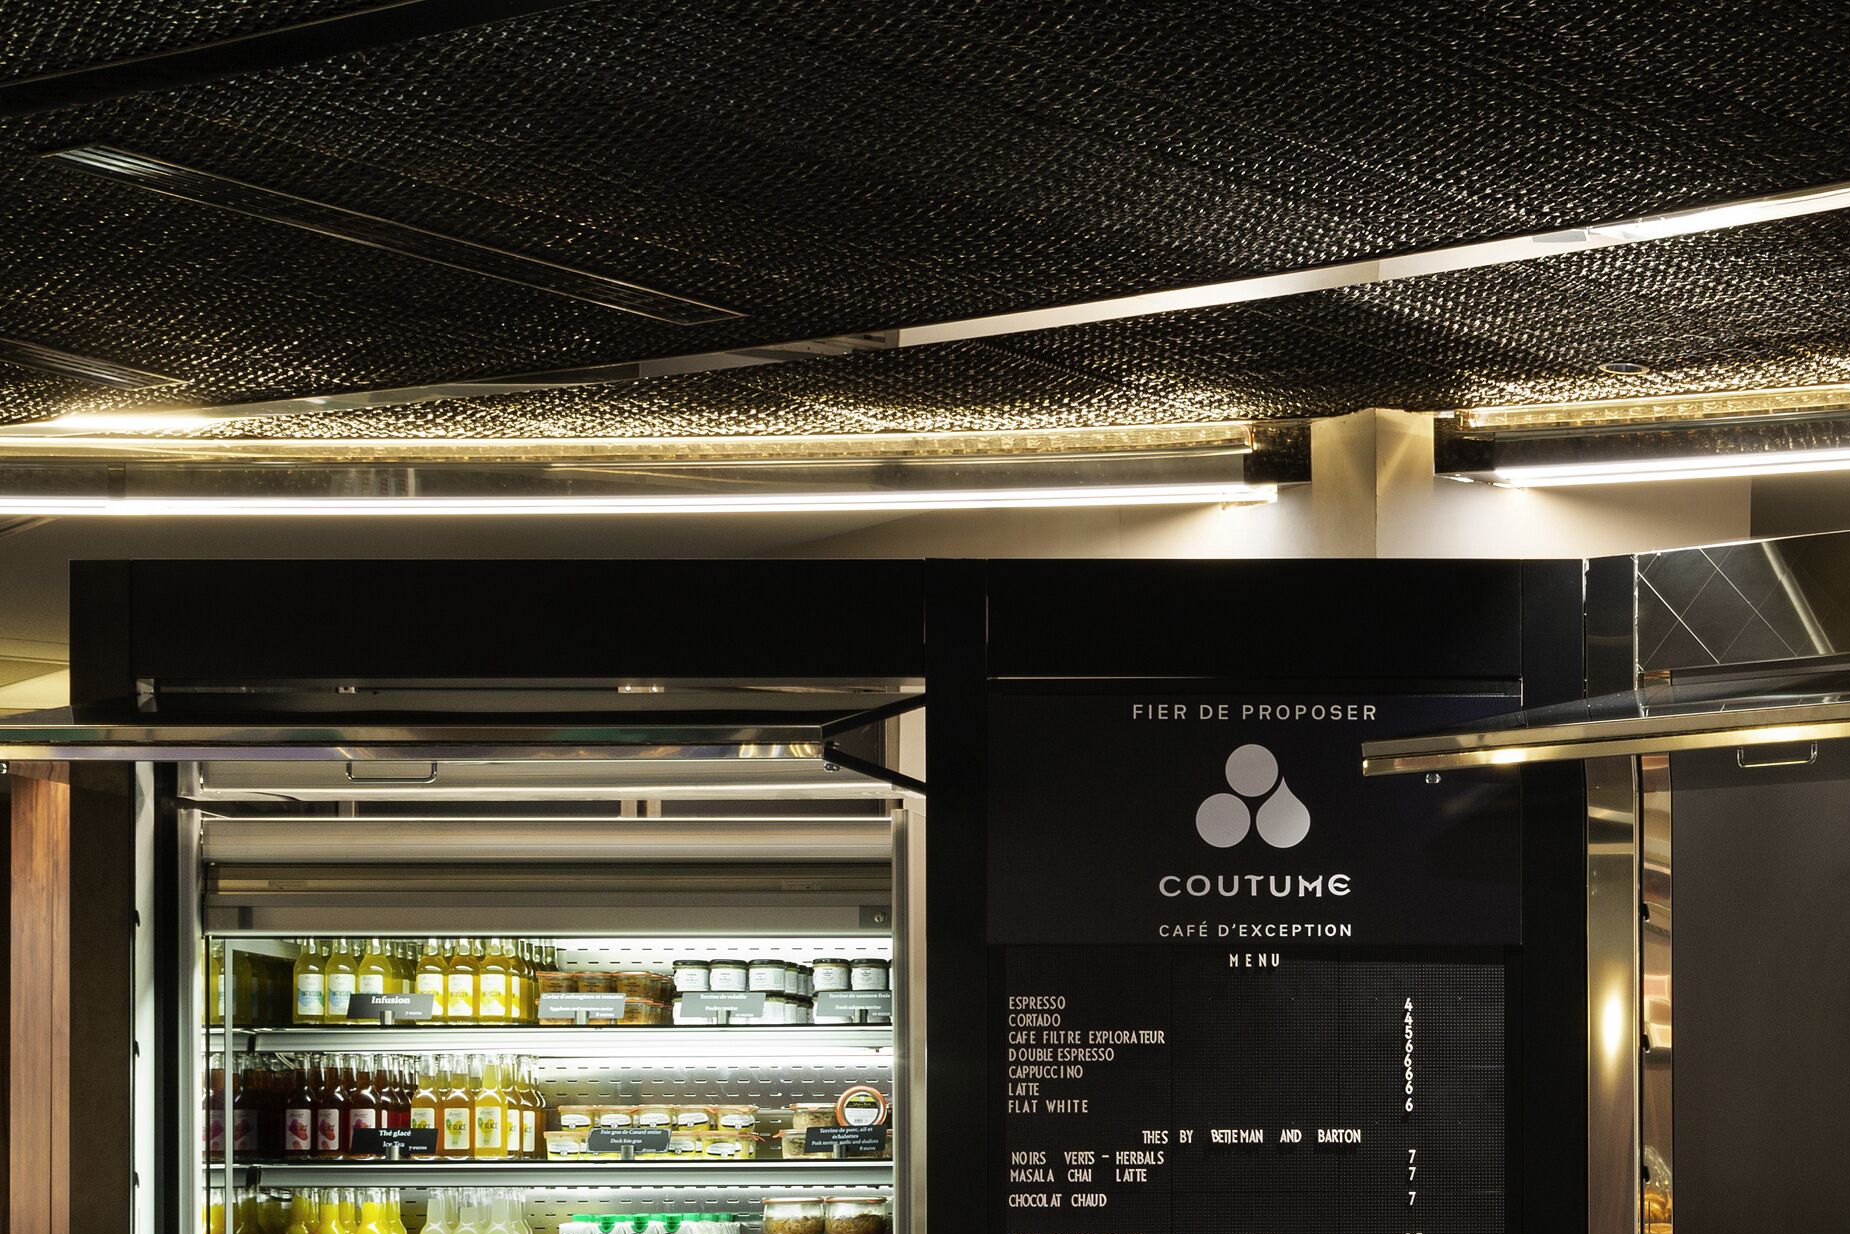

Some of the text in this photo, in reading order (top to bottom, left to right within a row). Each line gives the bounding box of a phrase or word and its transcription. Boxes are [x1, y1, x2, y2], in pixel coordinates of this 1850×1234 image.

[1133, 704, 1376, 721] FIER DE PROPOSER
[1159, 873, 1351, 898] COUTUME
[1159, 920, 1352, 937] CAFÉ D’EXCEPTION
[1229, 953, 1280, 968] MENU
[371, 996, 411, 1004] Infusion
[1009, 995, 1066, 1010] ESPRESSO
[1403, 997, 1414, 1012] 4
[1008, 1013, 1061, 1028] CORTADO
[1403, 1012, 1414, 1026] 4
[1008, 1030, 1166, 1045] CAFE FILTRE EXPLORATEUR
[1404, 1025, 1414, 1041] 5
[1008, 1047, 1115, 1062] DOUBLE ESPRESSO
[1405, 1039, 1414, 1055] 6
[1403, 1053, 1413, 1068] 6
[1008, 1064, 1084, 1079] CAPPUCCINO
[1404, 1066, 1414, 1081] 6
[1008, 1082, 1040, 1096] LATTE
[1405, 1080, 1414, 1095] 6
[1008, 1099, 1088, 1114] FLAT WHITE
[1405, 1097, 1414, 1112] 6
[393, 1130, 411, 1138] glacé
[1141, 1130, 1169, 1145] THES
[1179, 1129, 1194, 1144] BY
[1279, 1128, 1303, 1143] AND
[1317, 1128, 1362, 1144] BARTON
[1011, 1150, 1165, 1166] NOIRS VERTS HERBALS
[1408, 1149, 1417, 1164] 7
[1010, 1168, 1148, 1183] MASALA CHAI LATTE
[1408, 1166, 1417, 1181] 7
[1008, 1193, 1108, 1208] CHOCOLAT CHAUD
[1408, 1191, 1417, 1206] 7
